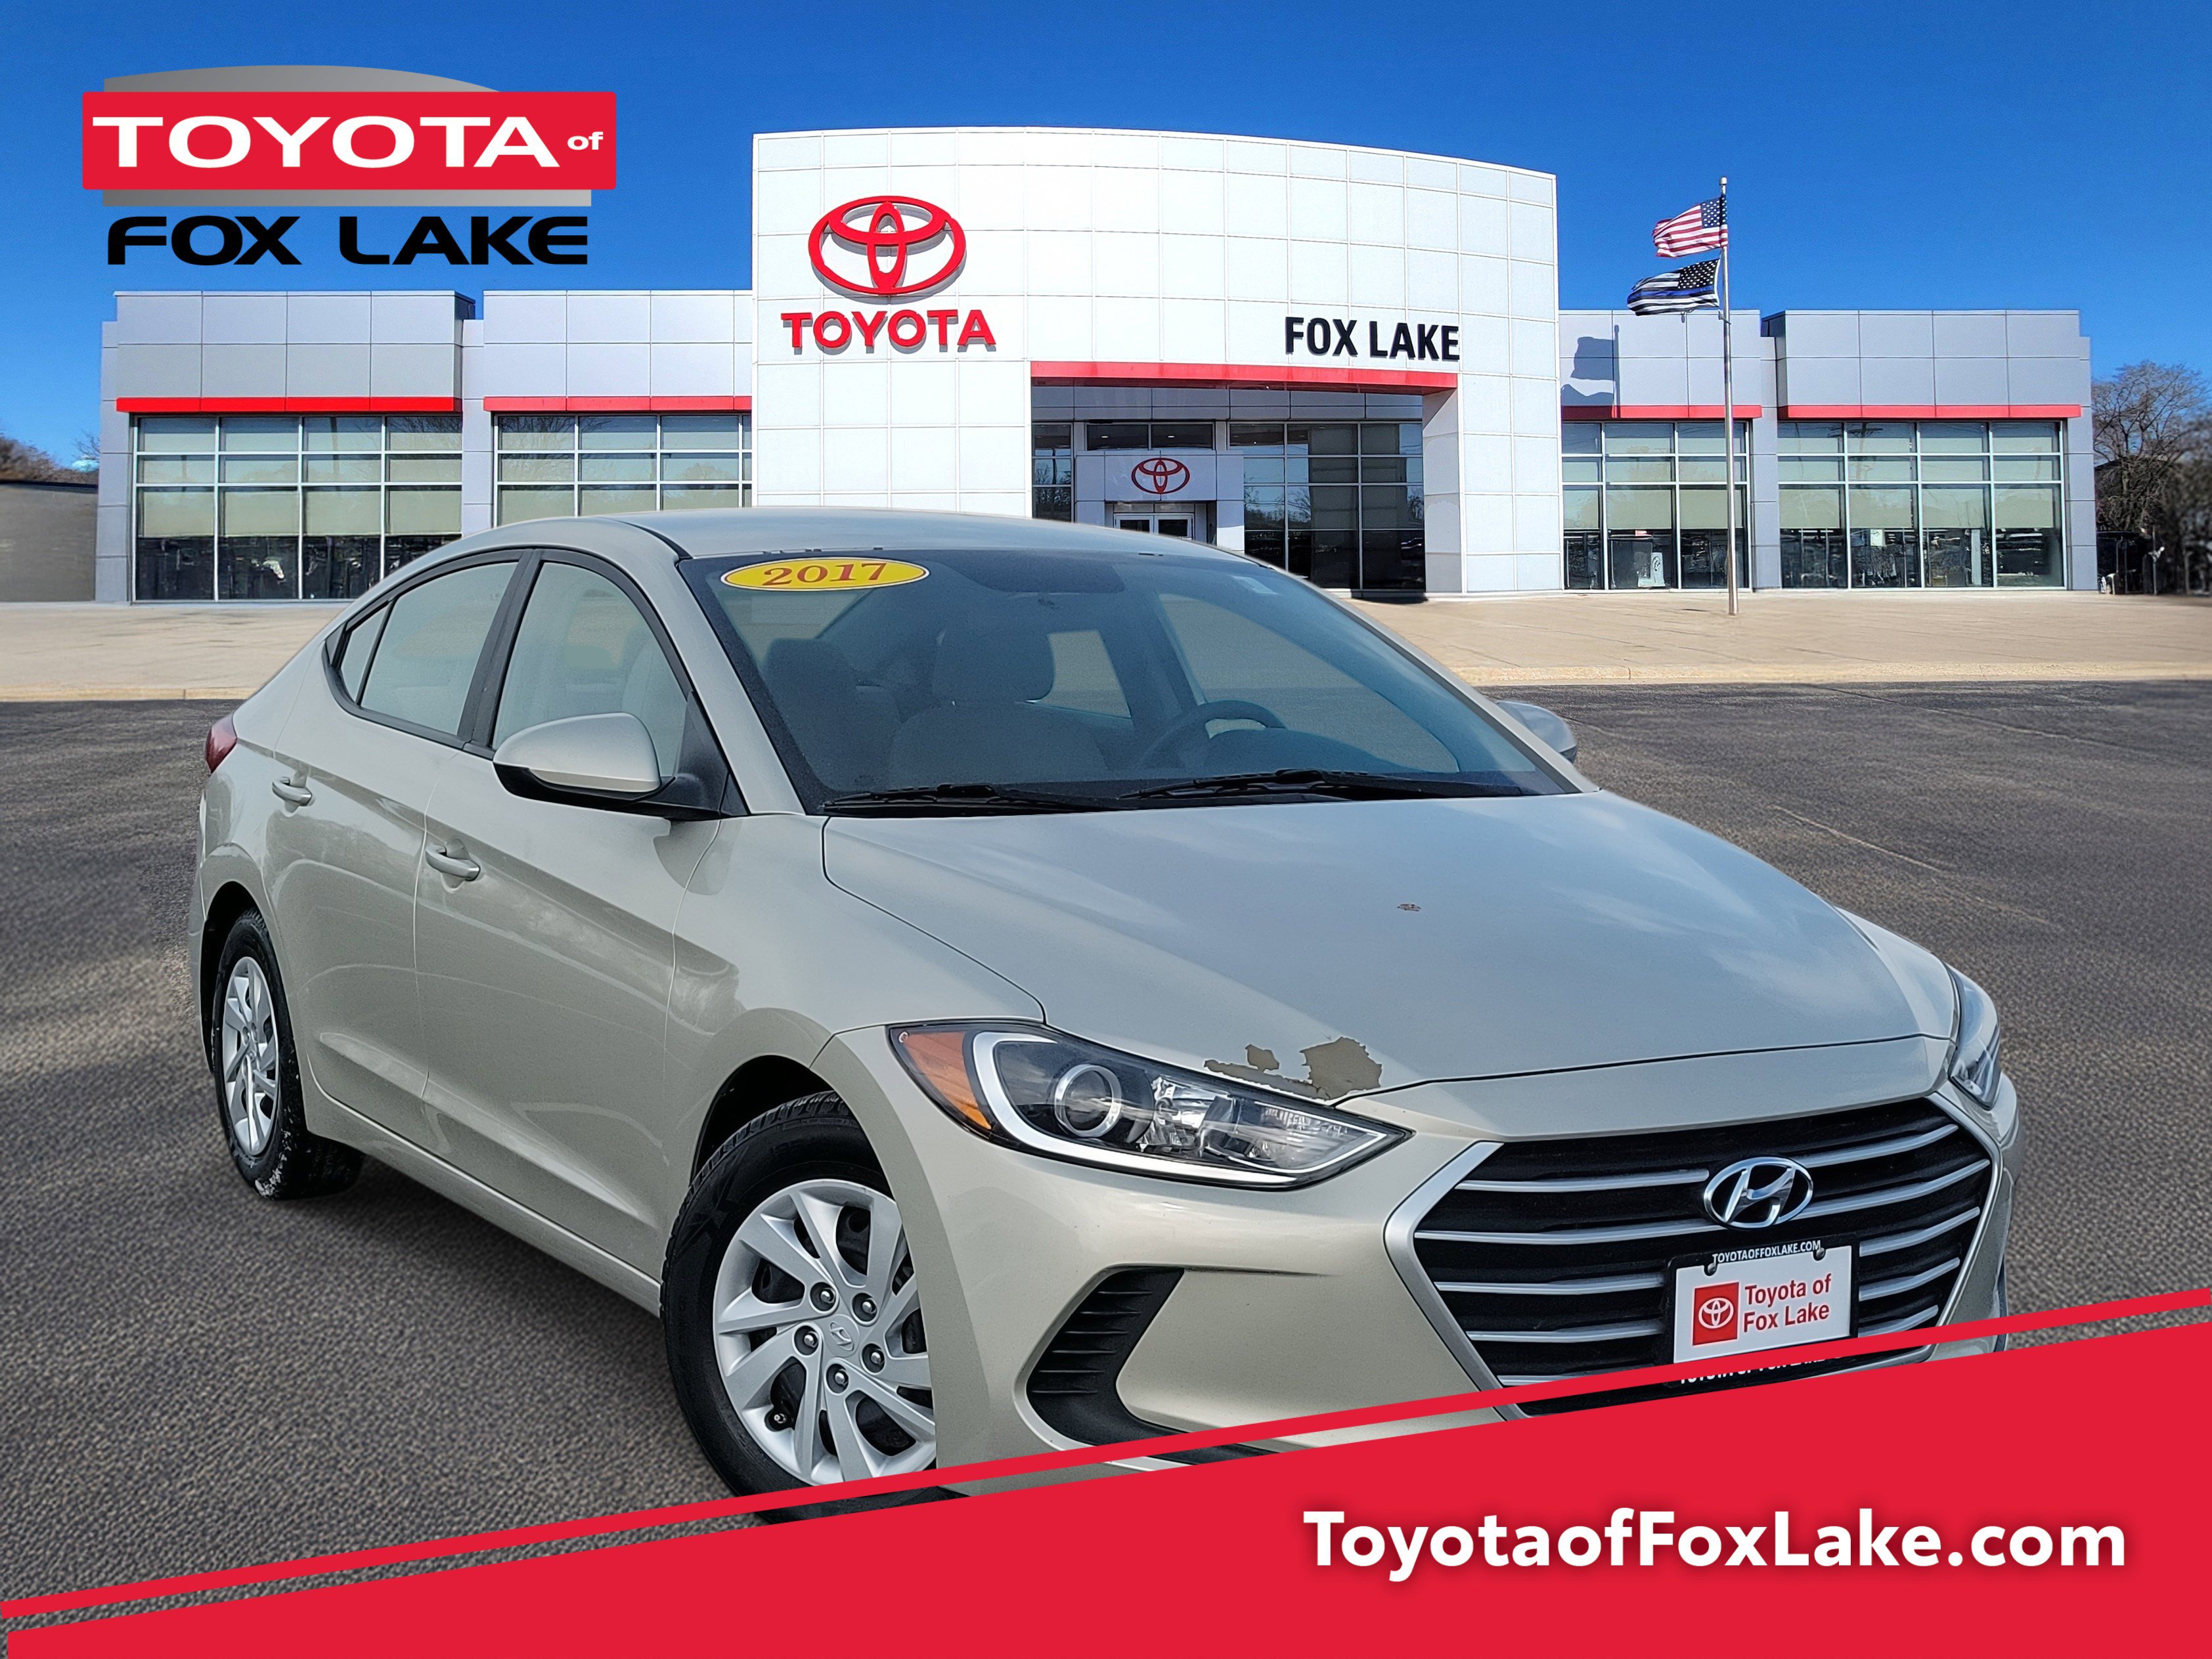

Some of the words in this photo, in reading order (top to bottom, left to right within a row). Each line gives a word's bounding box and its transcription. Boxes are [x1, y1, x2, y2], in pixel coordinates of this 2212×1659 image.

[781, 309, 996, 350] TOYOTA
[1285, 317, 1358, 357] FOX
[1369, 321, 1460, 361] LAKE
[762, 563, 887, 586] 2017
[1712, 1240, 1821, 1264] TOYOTAOFFOXLAKE.COM
[1744, 1280, 1806, 1308] Toyota
[1813, 1273, 1832, 1294] of
[1744, 1312, 1779, 1333] Fox
[1785, 1302, 1830, 1325] Lake
